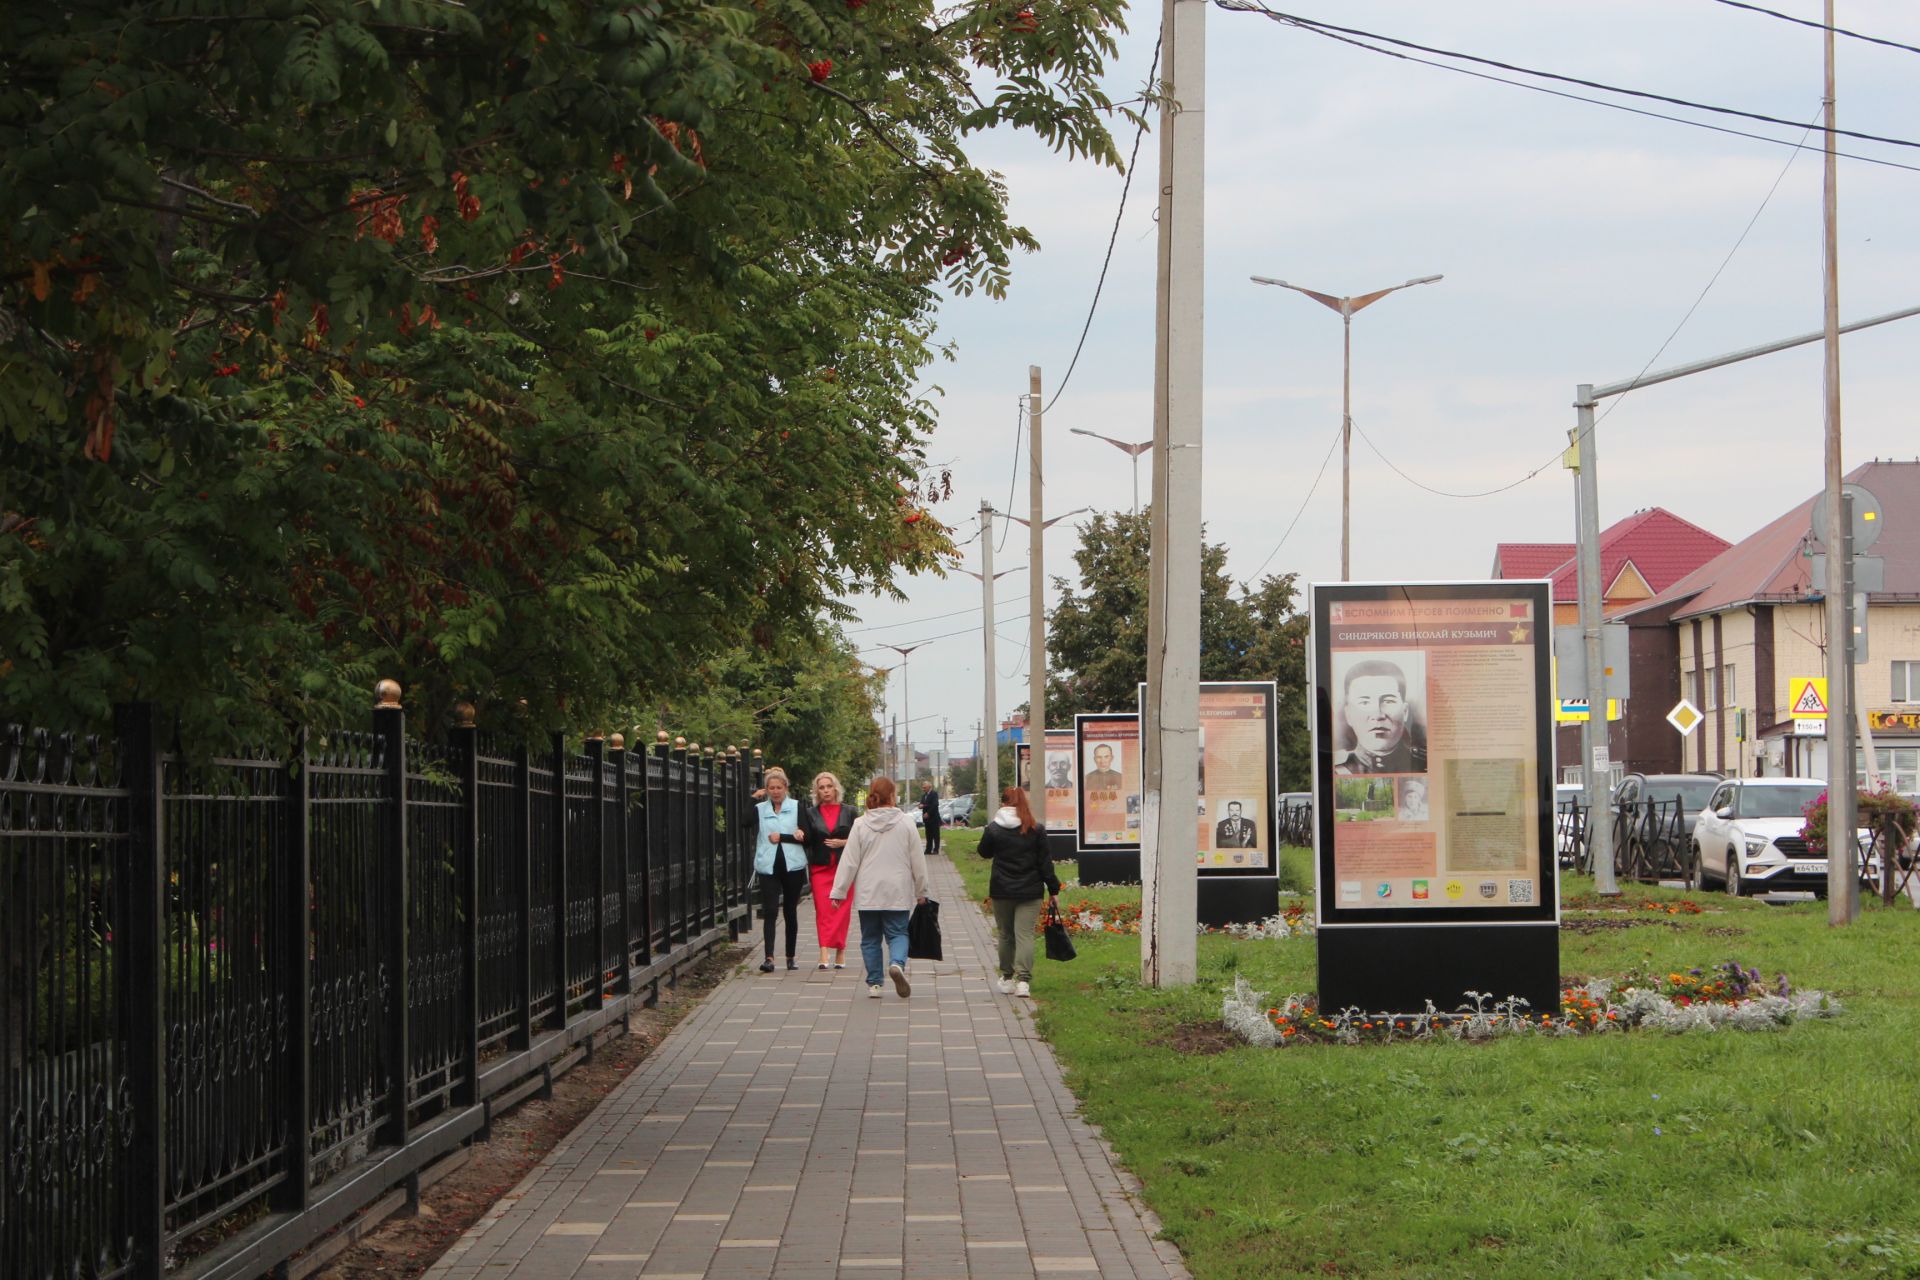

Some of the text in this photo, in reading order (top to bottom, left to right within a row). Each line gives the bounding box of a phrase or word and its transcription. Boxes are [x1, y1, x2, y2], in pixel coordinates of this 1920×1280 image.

[1345, 606, 1504, 618] ВСПОМНИМ ГЕРОЕВ ПОИМЕННО
[1338, 629, 1497, 641] СИНДРЯКОВ НИКОЛАЙ КУЗЬМИЧ
